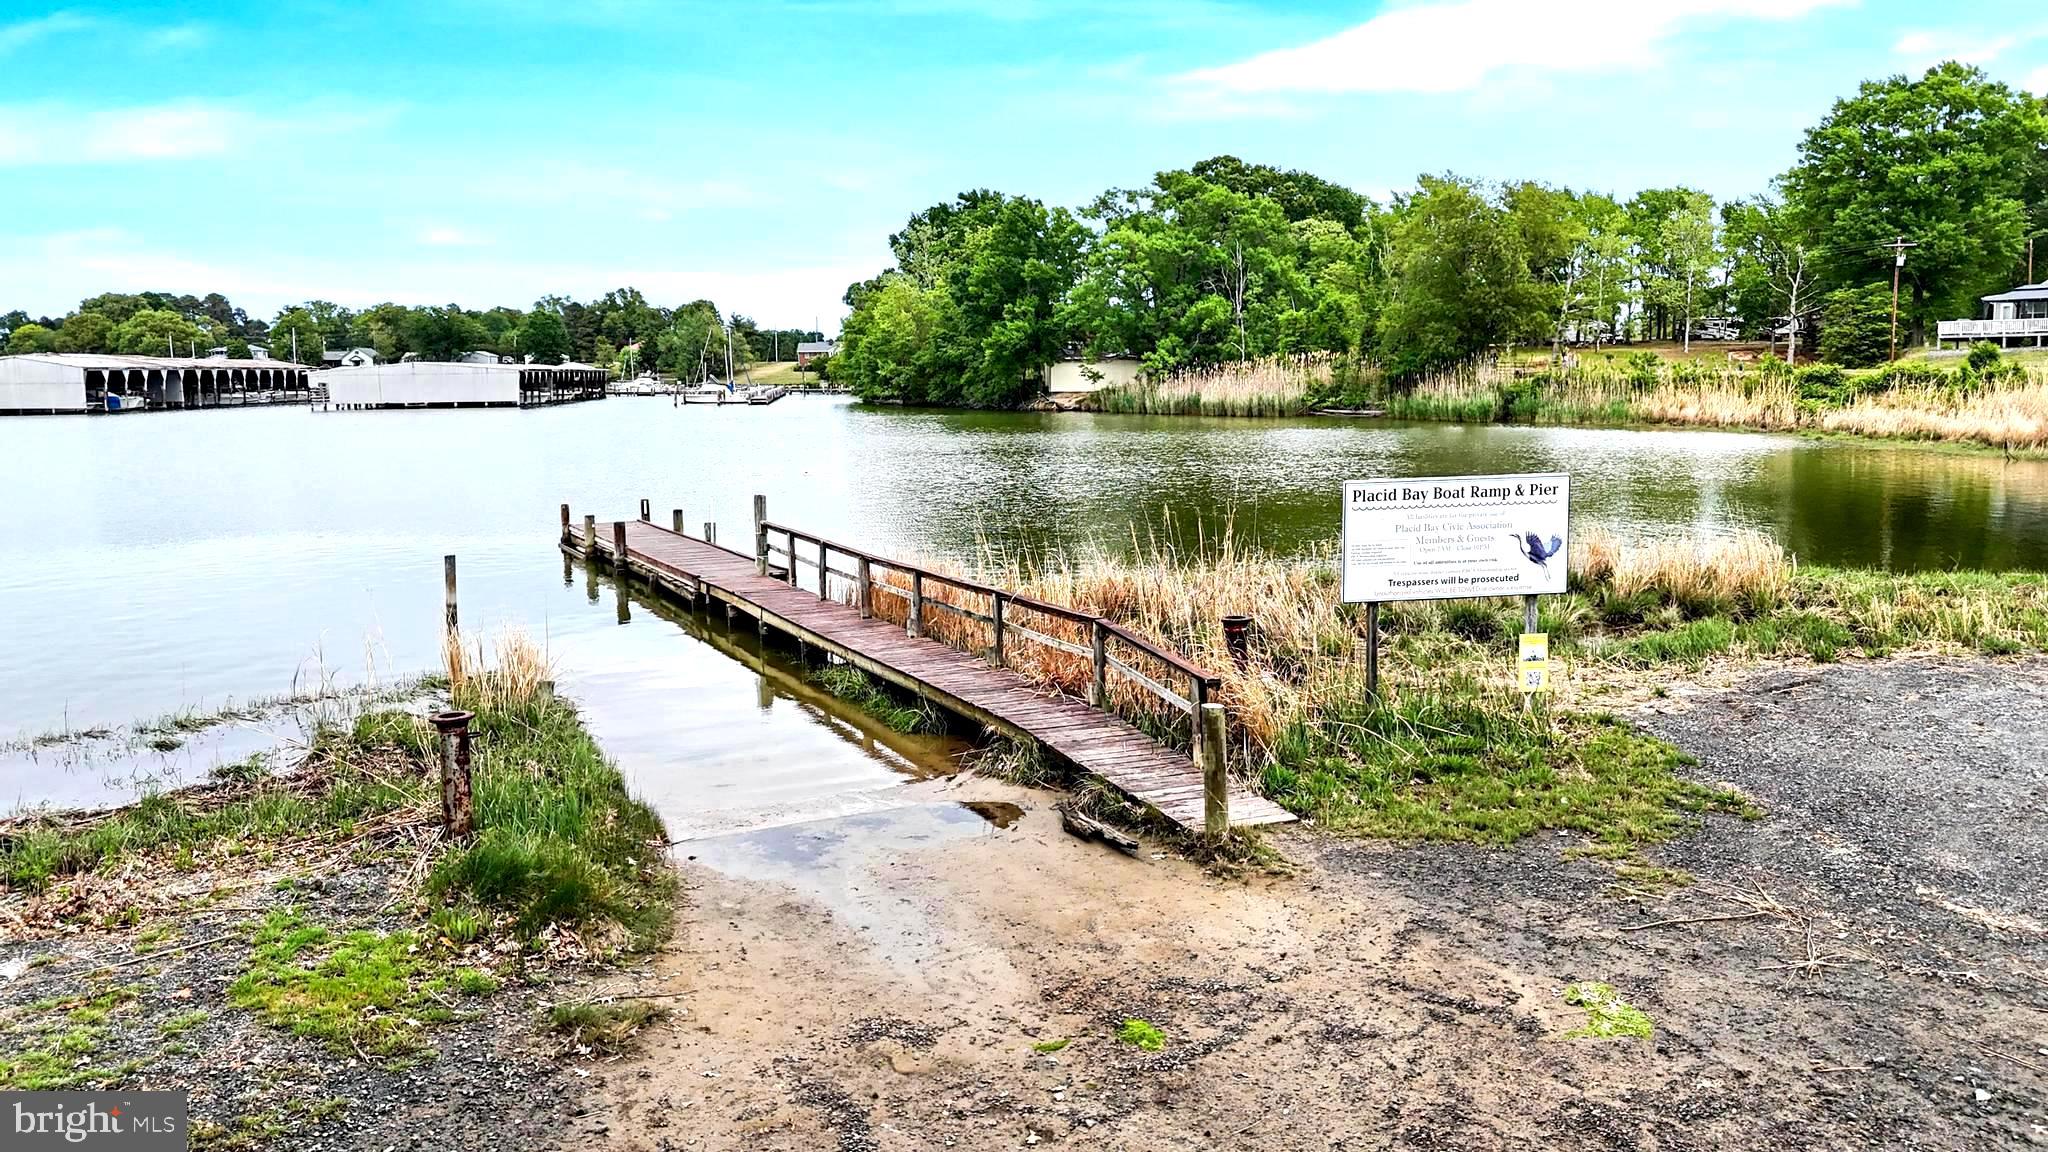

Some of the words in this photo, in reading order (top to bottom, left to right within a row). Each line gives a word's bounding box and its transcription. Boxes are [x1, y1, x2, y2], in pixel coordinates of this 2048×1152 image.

[1352, 488, 1397, 503] Placid
[1402, 487, 1428, 504] Bay
[1433, 486, 1465, 500] Boat
[1470, 484, 1511, 500] Ramp
[1515, 484, 1525, 497] &
[1530, 483, 1559, 496] Pier
[1395, 524, 1421, 533] Placid
[1424, 523, 1439, 534] Bay
[1442, 522, 1464, 531] Civic
[1467, 521, 1513, 530] Association
[1415, 535, 1455, 545] Members
[1457, 534, 1464, 543] &
[1466, 533, 1495, 543] Guests
[1388, 578, 1439, 588] Trespassers
[1440, 576, 1456, 585] will
[1458, 575, 1469, 584] be
[1471, 573, 1520, 585] prosecuted
